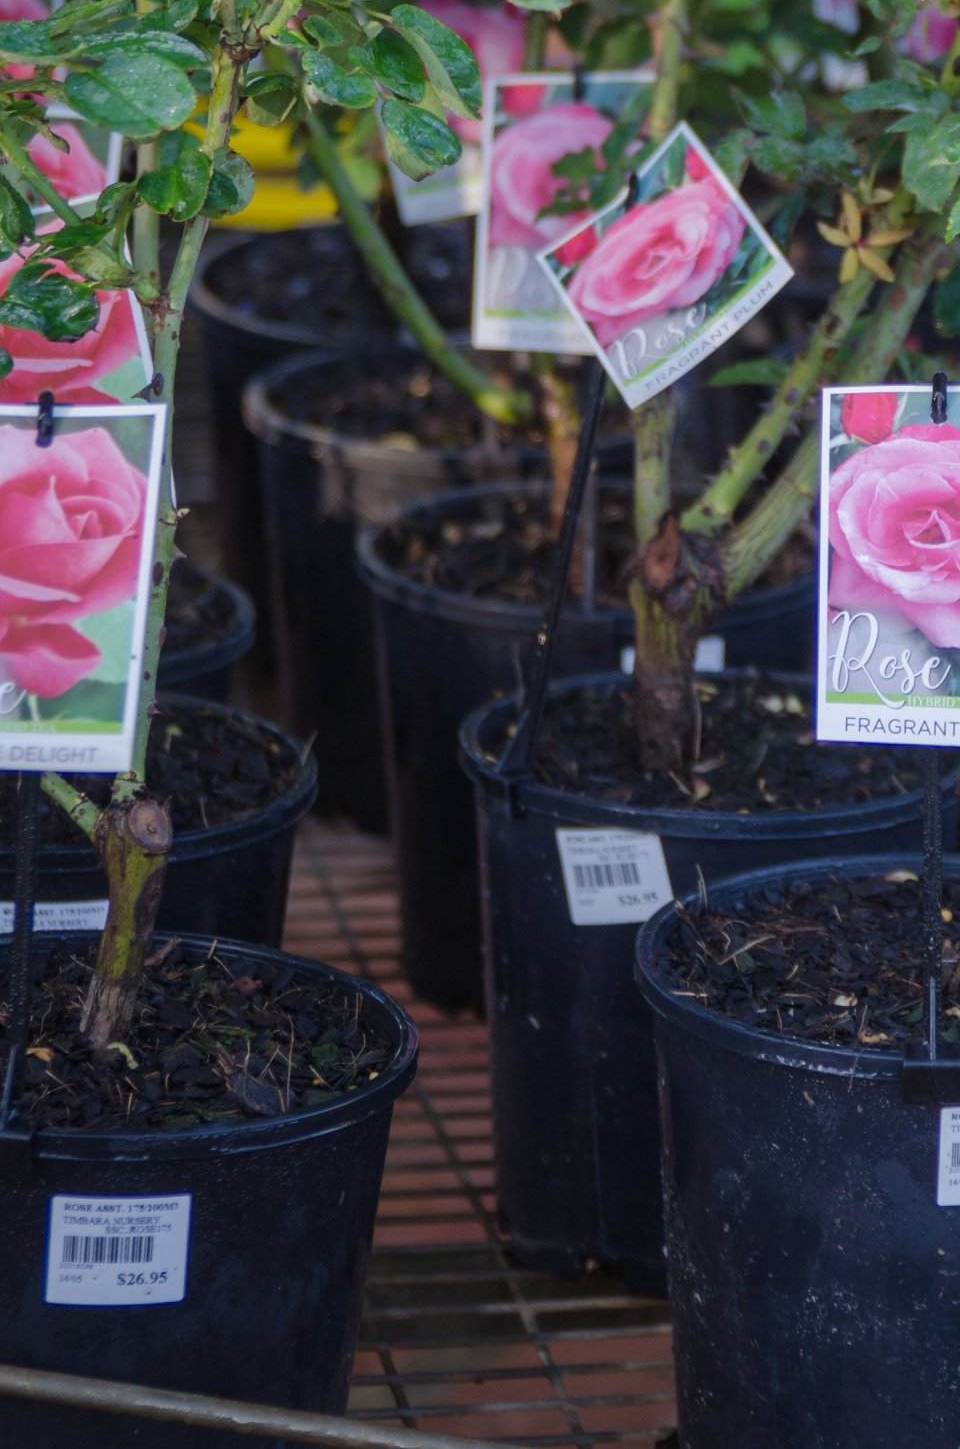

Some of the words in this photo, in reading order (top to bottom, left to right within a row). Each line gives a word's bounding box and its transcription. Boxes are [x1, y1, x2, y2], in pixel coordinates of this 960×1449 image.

[608, 302, 707, 379] Rose
[646, 322, 731, 391] FRAGRANT
[734, 281, 775, 321] PLUM
[828, 611, 952, 709] Rose
[907, 695, 955, 708] HYBRID
[844, 716, 960, 738] FRAGRANT
[9, 745, 98, 764] DELIGHT
[63, 1202, 94, 1212] ROSE
[95, 1203, 126, 1214] ASST.
[63, 1216, 110, 1225] TIMBARA
[112, 1216, 161, 1225] NURSERY
[116, 1271, 168, 1287] $26.95
